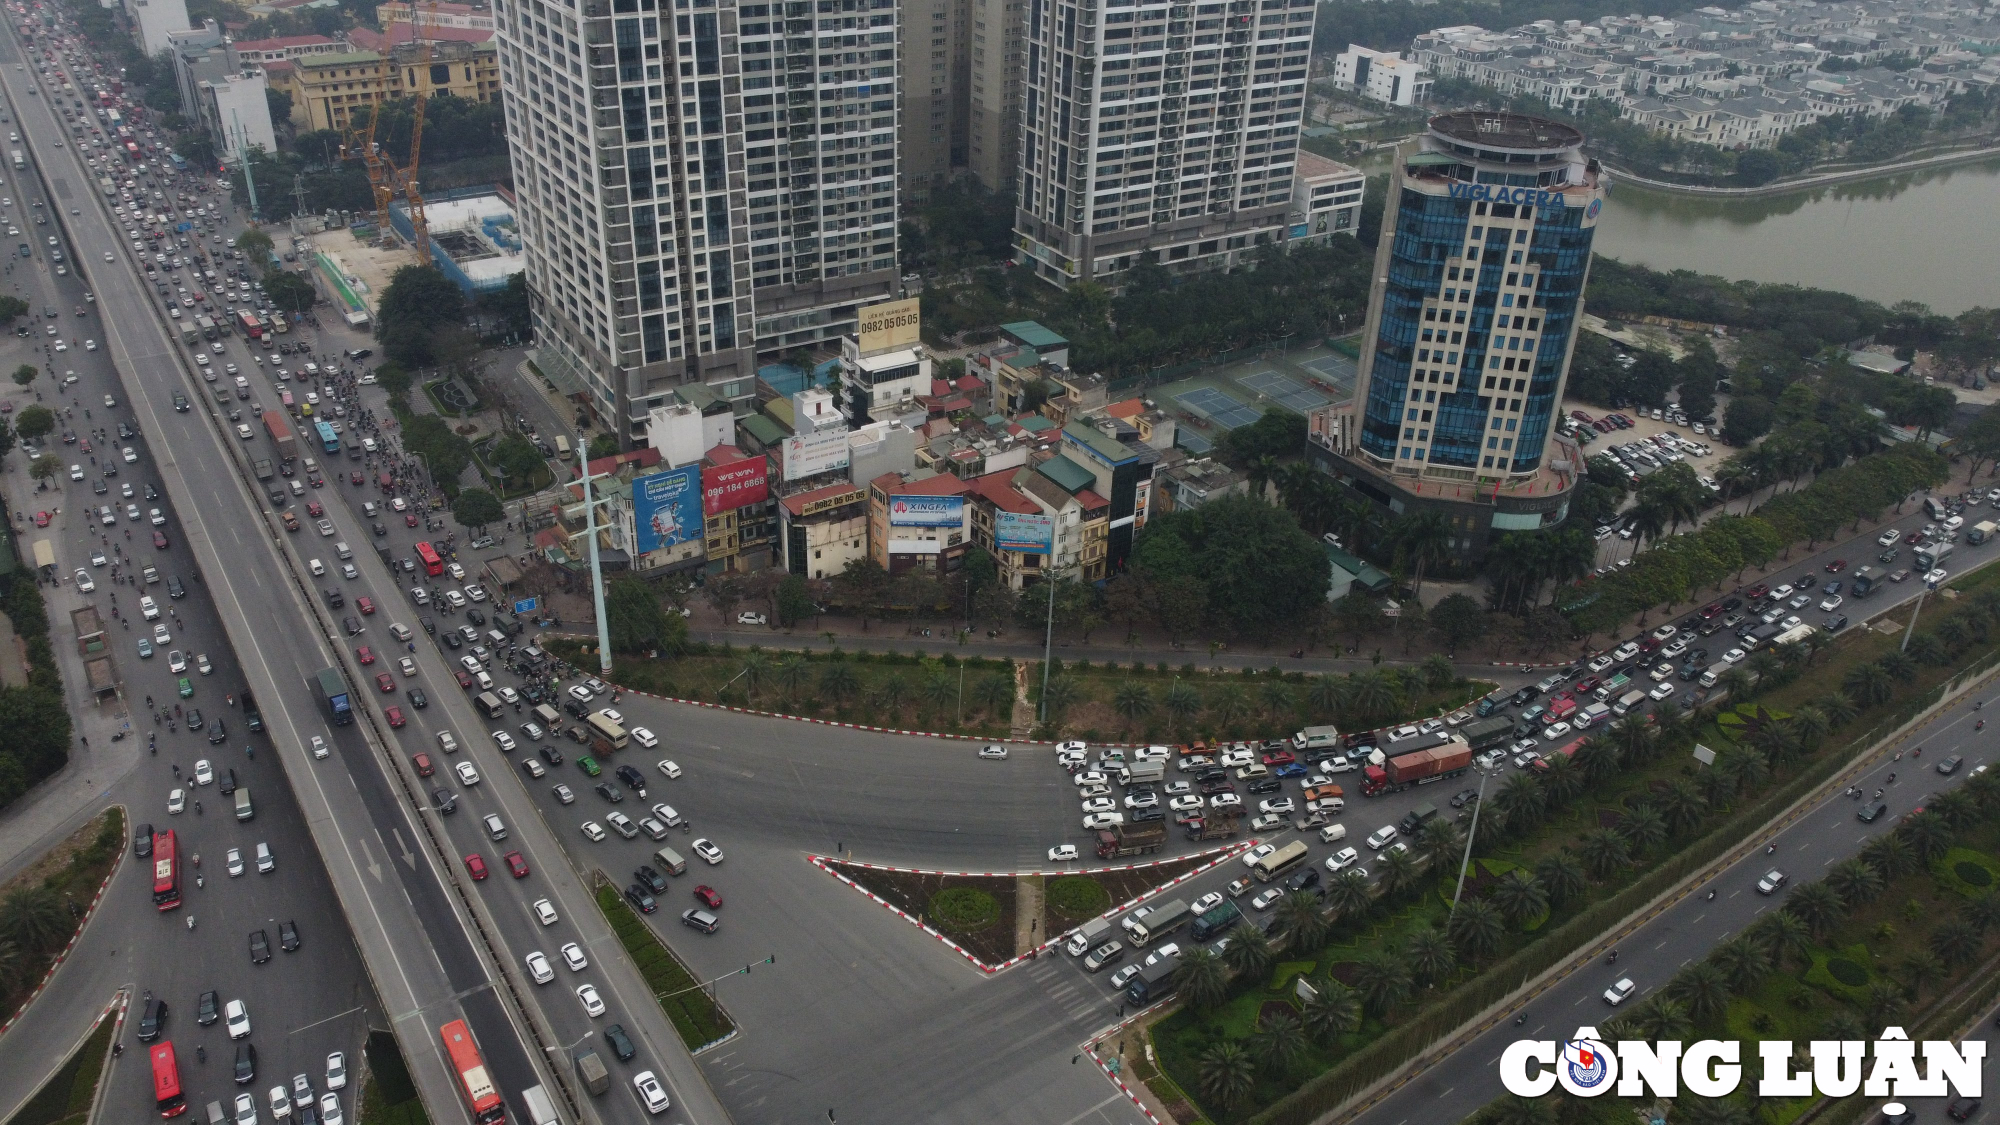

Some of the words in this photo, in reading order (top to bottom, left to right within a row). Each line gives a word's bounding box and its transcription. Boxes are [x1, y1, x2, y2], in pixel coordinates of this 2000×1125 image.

[1448, 183, 1565, 209] VIGLACERA
[861, 320, 883, 333] 0982
[884, 317, 895, 329] 05
[896, 315, 906, 327] 05
[907, 313, 918, 325] 05
[718, 472, 734, 481] WE
[735, 467, 754, 478] WIN
[707, 486, 724, 497] 096
[726, 482, 742, 492] 184
[744, 476, 765, 488] 6868
[814, 499, 832, 510] 0982
[834, 497, 844, 505] 05
[845, 494, 854, 502] 05
[855, 490, 865, 500] 05
